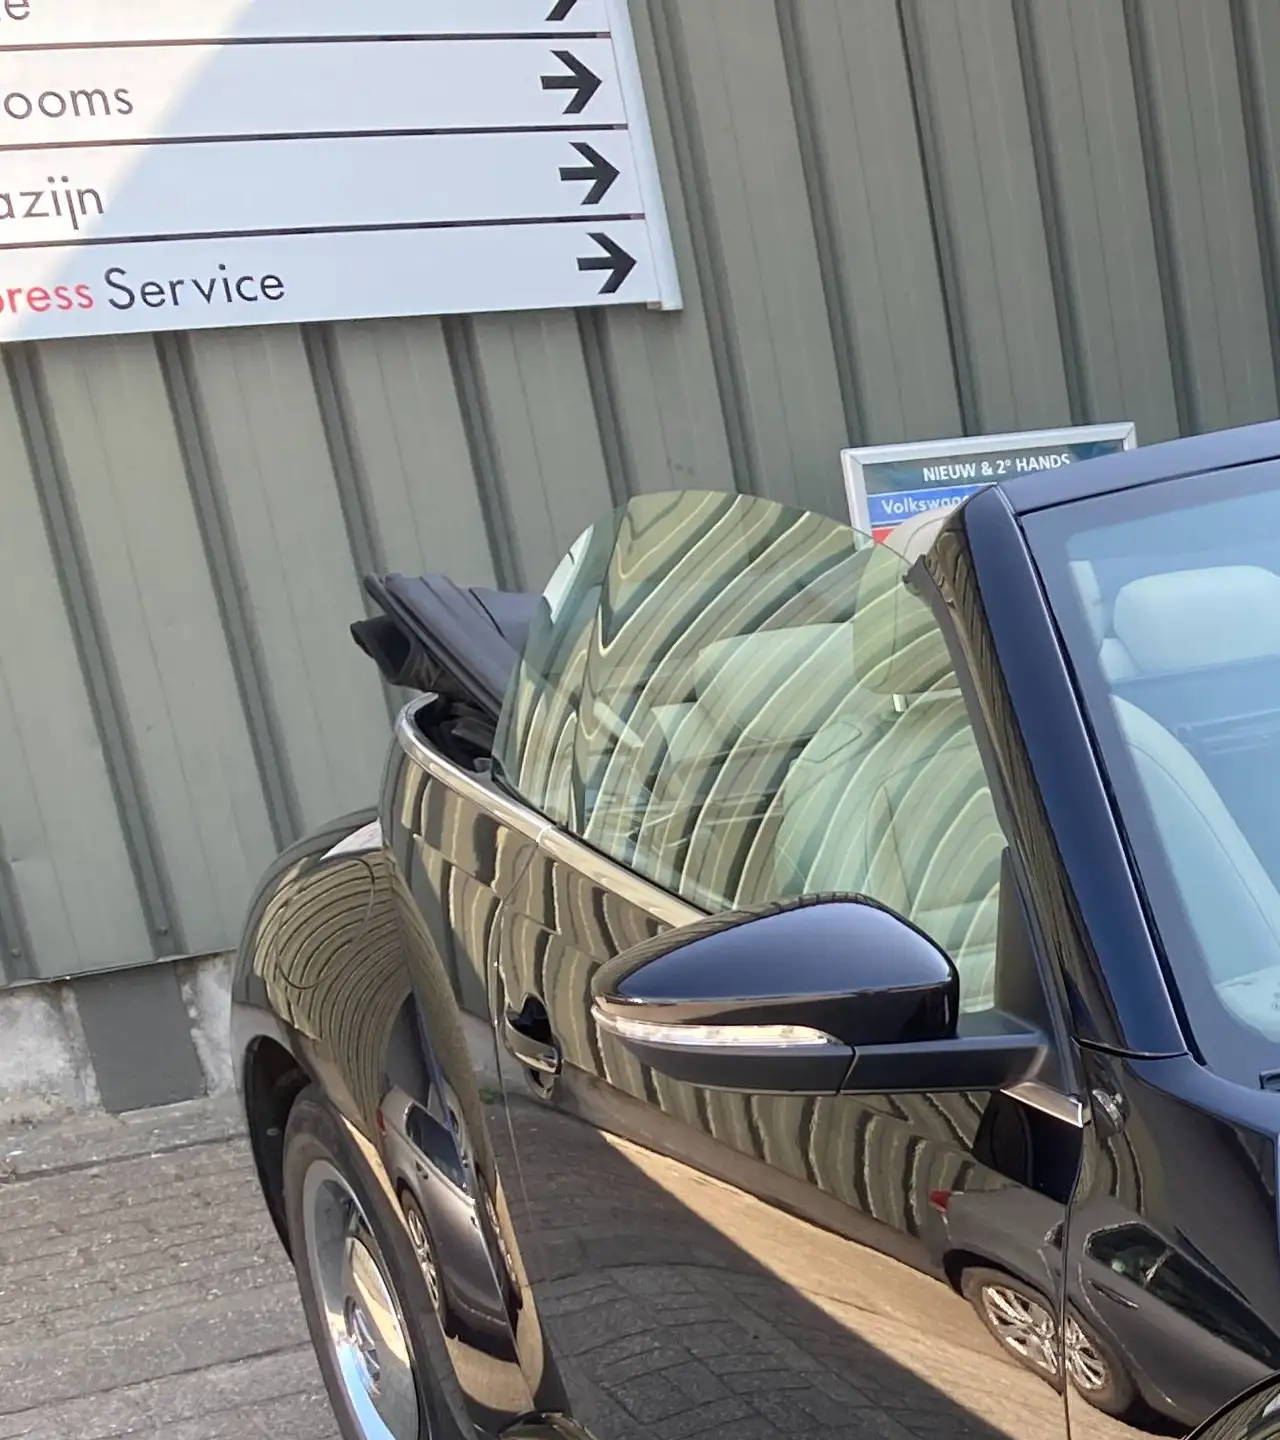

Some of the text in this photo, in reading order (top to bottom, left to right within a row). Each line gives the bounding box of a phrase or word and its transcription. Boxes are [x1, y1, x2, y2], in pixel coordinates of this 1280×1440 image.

[3, 87, 134, 120] ooms
[0, 263, 285, 314] ress Service
[922, 462, 976, 482] NIEUW
[981, 463, 993, 476] &
[1016, 453, 1070, 473] HANDS
